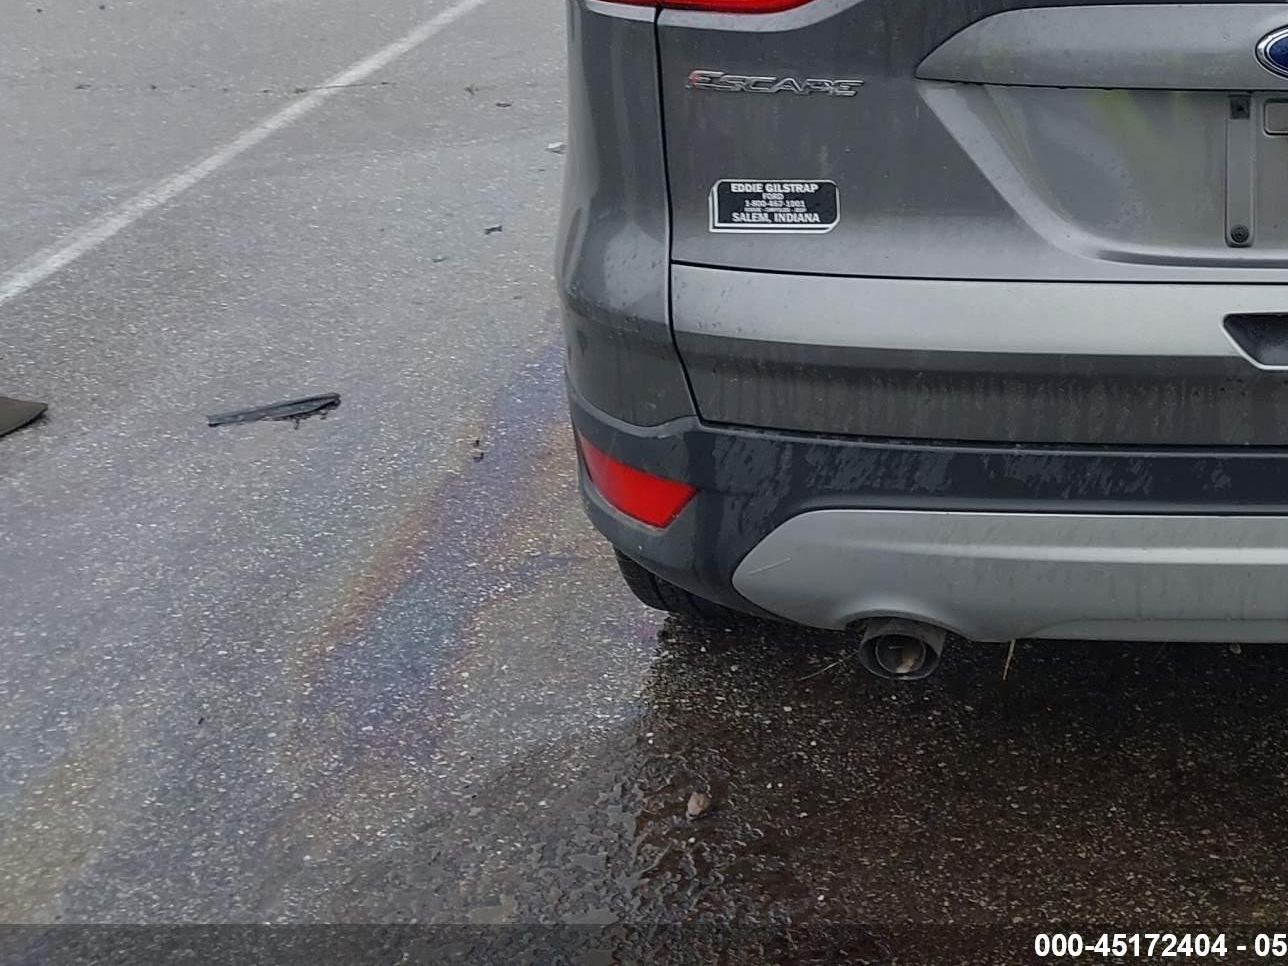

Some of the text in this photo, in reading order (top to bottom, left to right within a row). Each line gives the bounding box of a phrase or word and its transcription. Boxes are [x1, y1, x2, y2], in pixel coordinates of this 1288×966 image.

[687, 69, 865, 97] ESCAPE
[730, 183, 819, 193] EDDIE GILSTRAP
[732, 212, 821, 223] SALEM, INDIANA
